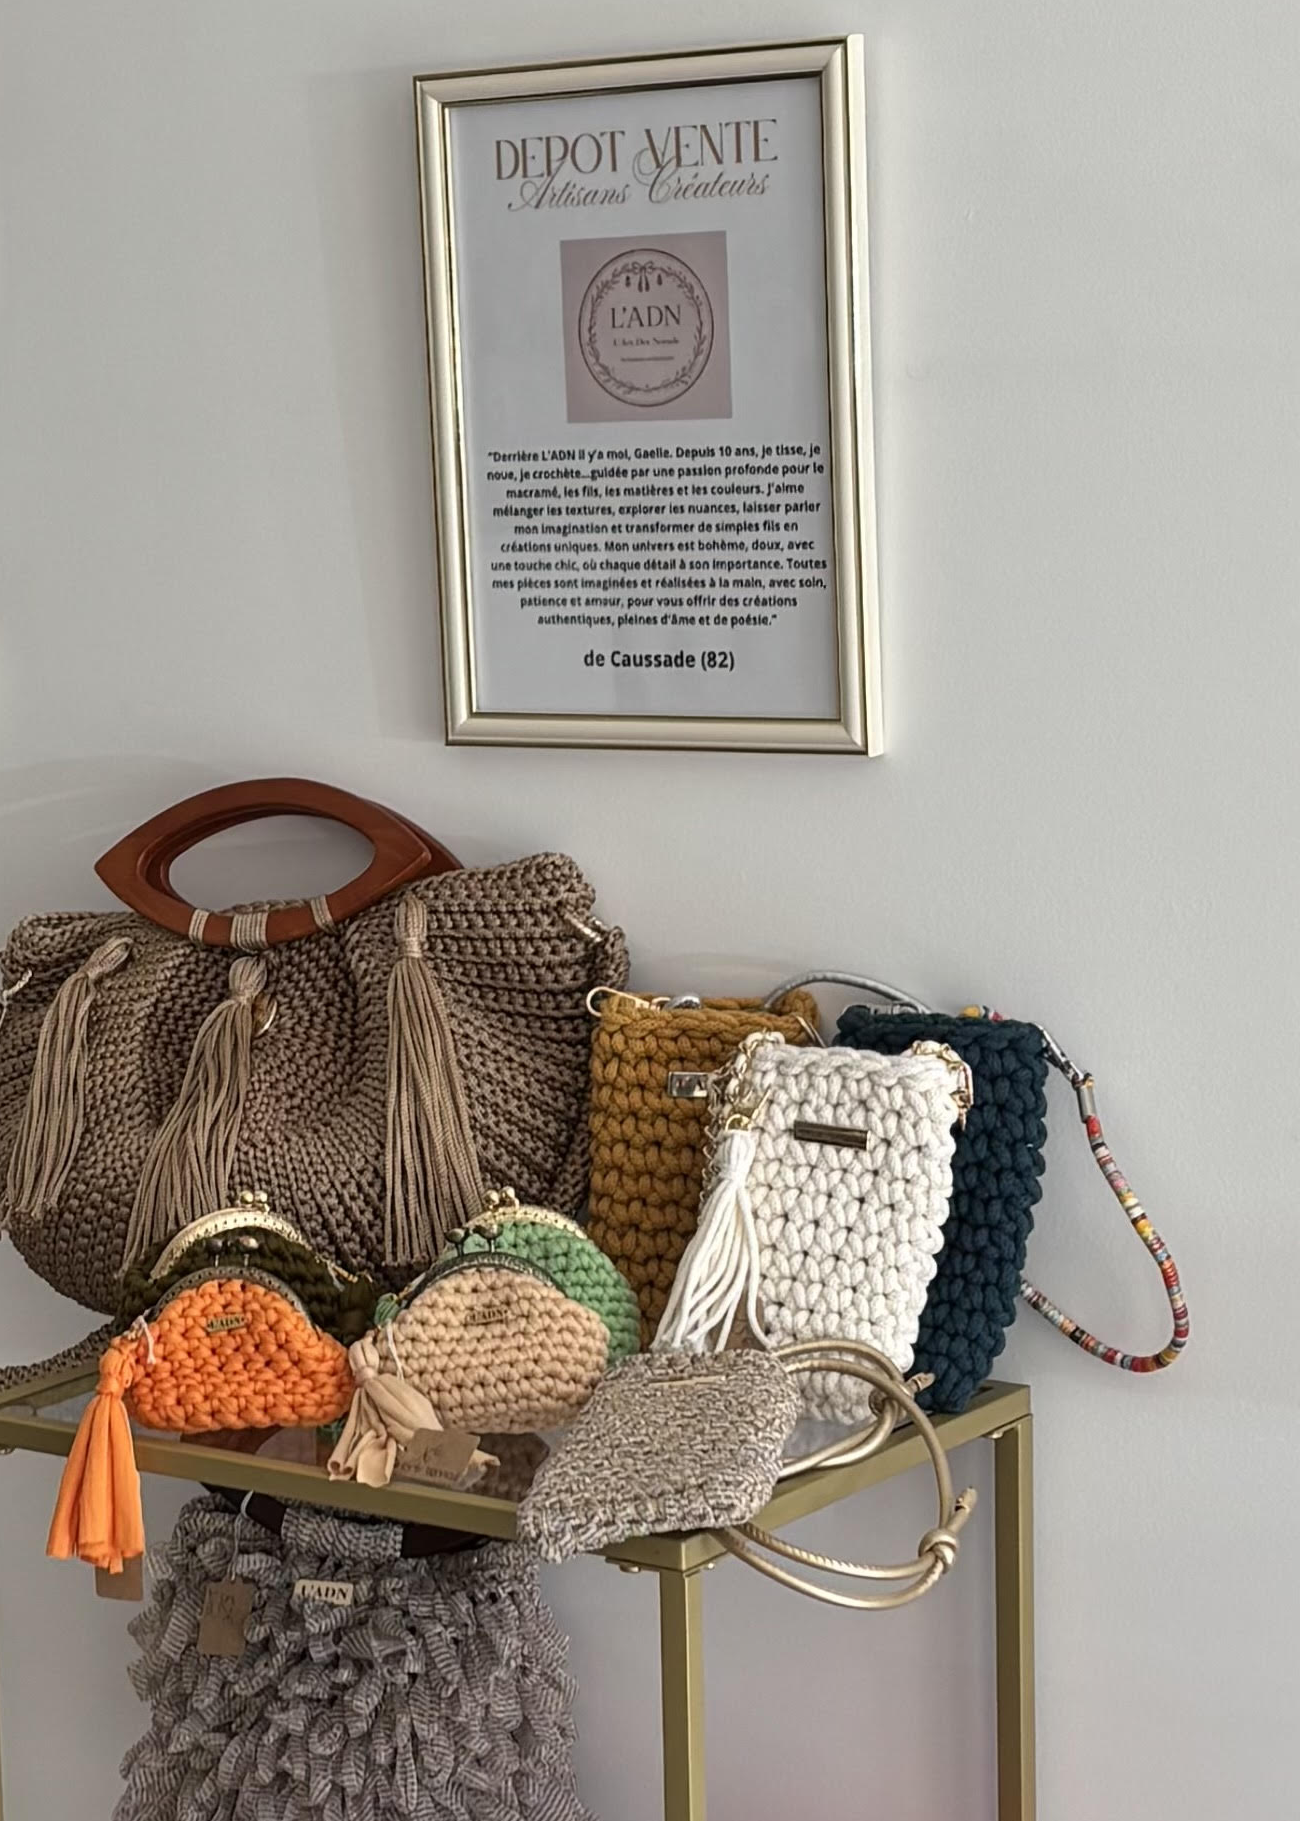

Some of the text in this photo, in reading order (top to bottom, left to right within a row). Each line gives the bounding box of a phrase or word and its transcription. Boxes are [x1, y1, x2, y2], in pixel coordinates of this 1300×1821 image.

[495, 118, 778, 181] DEPOT VENTE
[507, 147, 770, 212] Artisans Créateurs
[611, 304, 680, 329] L'ADN
[542, 449, 576, 461] L'ADN
[579, 449, 586, 460] il
[607, 448, 632, 461] moi,
[676, 446, 716, 460] Depuis
[719, 445, 732, 456] 10
[735, 446, 759, 458] ans,
[761, 444, 773, 459] je
[776, 443, 807, 457] tisse,
[809, 442, 821, 458] je
[487, 470, 518, 482] noue,
[520, 468, 531, 482] je
[631, 467, 650, 480] par
[653, 467, 675, 477] une
[678, 464, 722, 479] passion
[725, 463, 779, 478] profonde
[782, 464, 811, 477] pour
[813, 461, 825, 474] le
[564, 485, 580, 497] les
[582, 484, 602, 499] fils,
[605, 485, 621, 497] les
[623, 483, 674, 496] matières
[677, 485, 689, 495] et
[692, 484, 708, 495] les
[710, 482, 764, 495] couleurs.
[766, 481, 805, 497] J'aime
[493, 499, 821, 519] mélanger les textures, explorer les nuances, laisser parler
[514, 519, 799, 537] mon imagination et transformer de simples fils en
[501, 541, 551, 552] créations
[605, 540, 629, 551] Mon
[632, 539, 675, 551] univers
[677, 540, 695, 551] est
[751, 538, 784, 552] doux,
[787, 540, 815, 550] avec
[491, 557, 828, 572] une touche chic, où chaque détail à son importance. Toutes
[492, 575, 827, 591] mes pièces sont imaginées et réalisées à la main, avec soin,
[520, 594, 798, 609] patience et amour, pour vous offrir des créations
[538, 614, 615, 628] authentiques,
[618, 613, 658, 628] pleines
[661, 613, 696, 625] d'âme
[699, 614, 711, 625] et
[713, 613, 728, 625] de
[583, 649, 735, 672] de Caussade (82)
